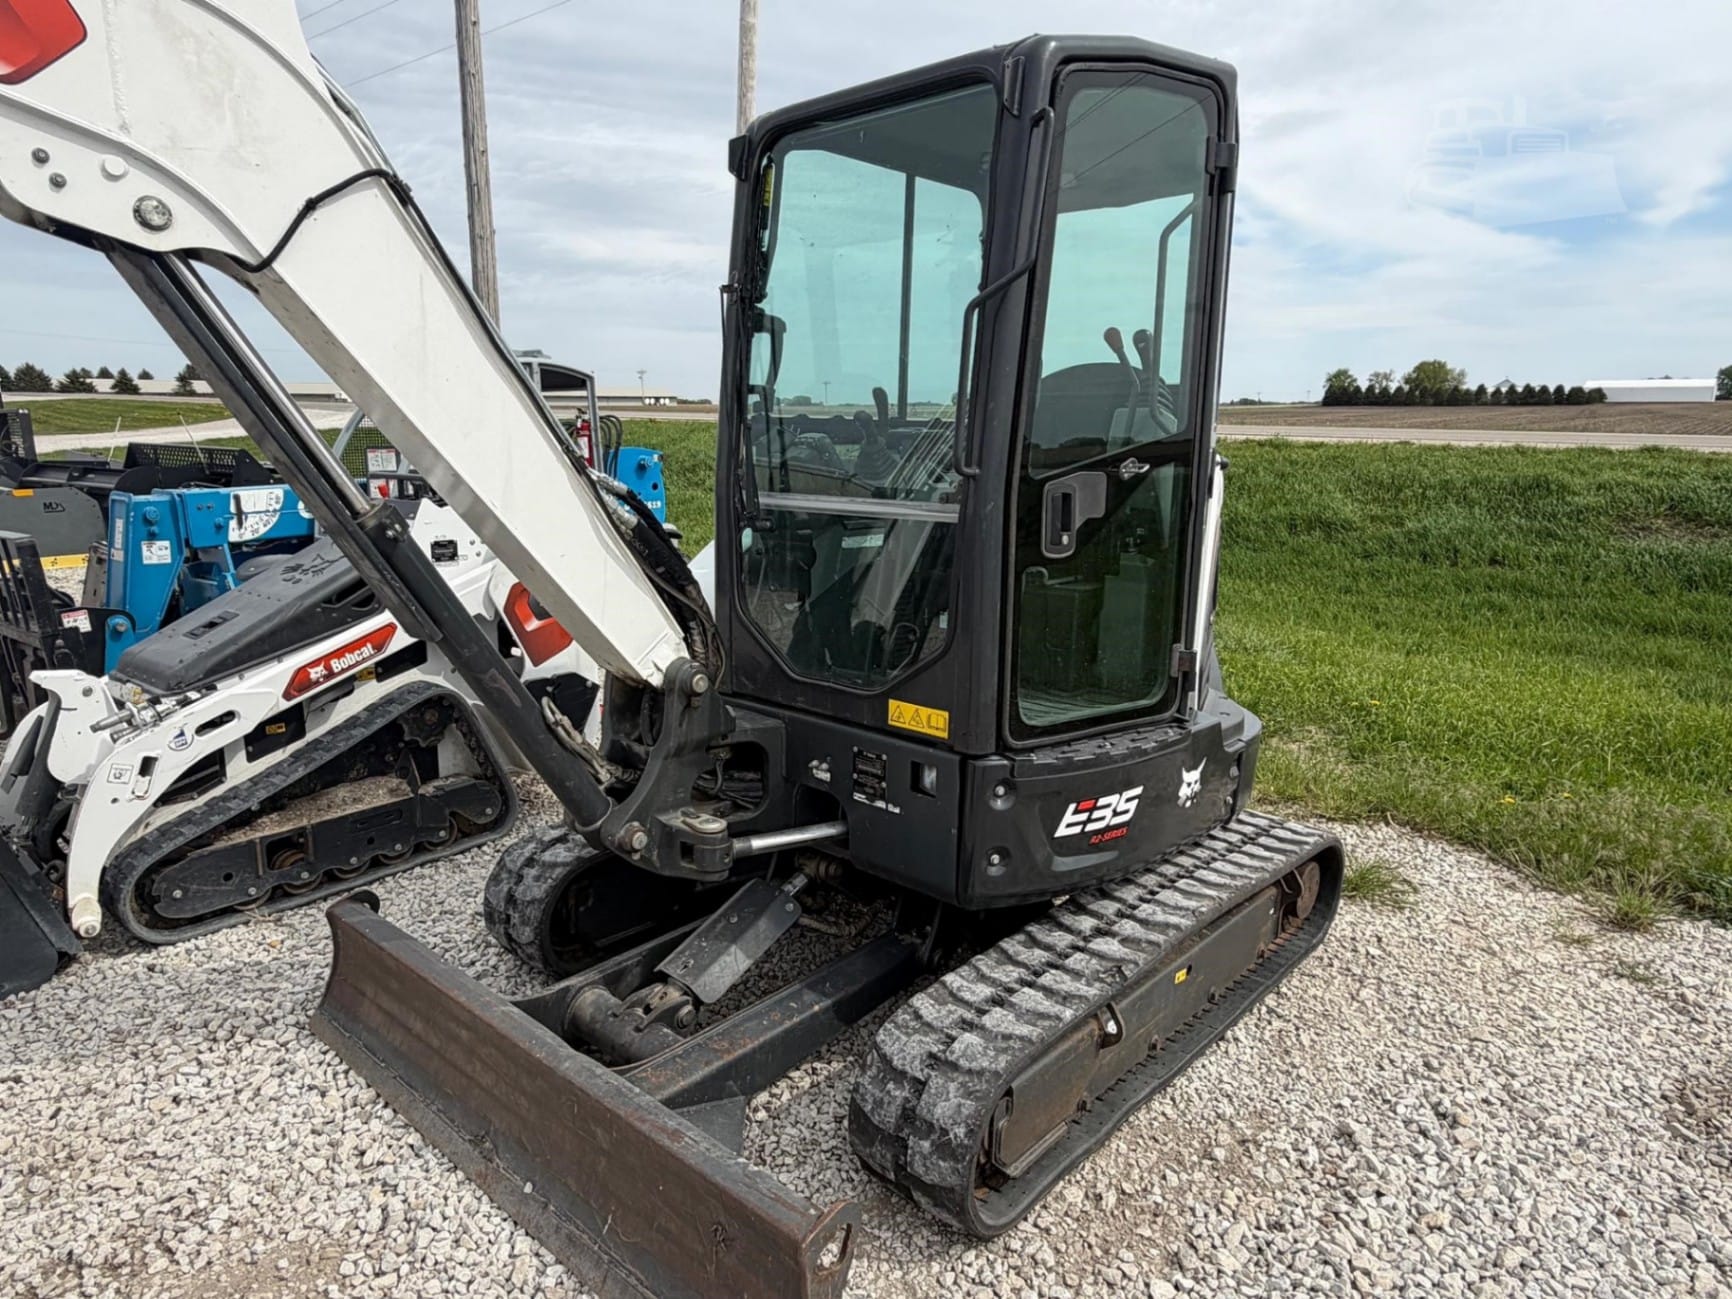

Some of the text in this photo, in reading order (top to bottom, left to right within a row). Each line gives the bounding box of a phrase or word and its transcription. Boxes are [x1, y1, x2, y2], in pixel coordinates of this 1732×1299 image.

[330, 643, 374, 673] Bobcat
[1053, 785, 1145, 838] E35
[1089, 826, 1129, 845] R2-SERIES
